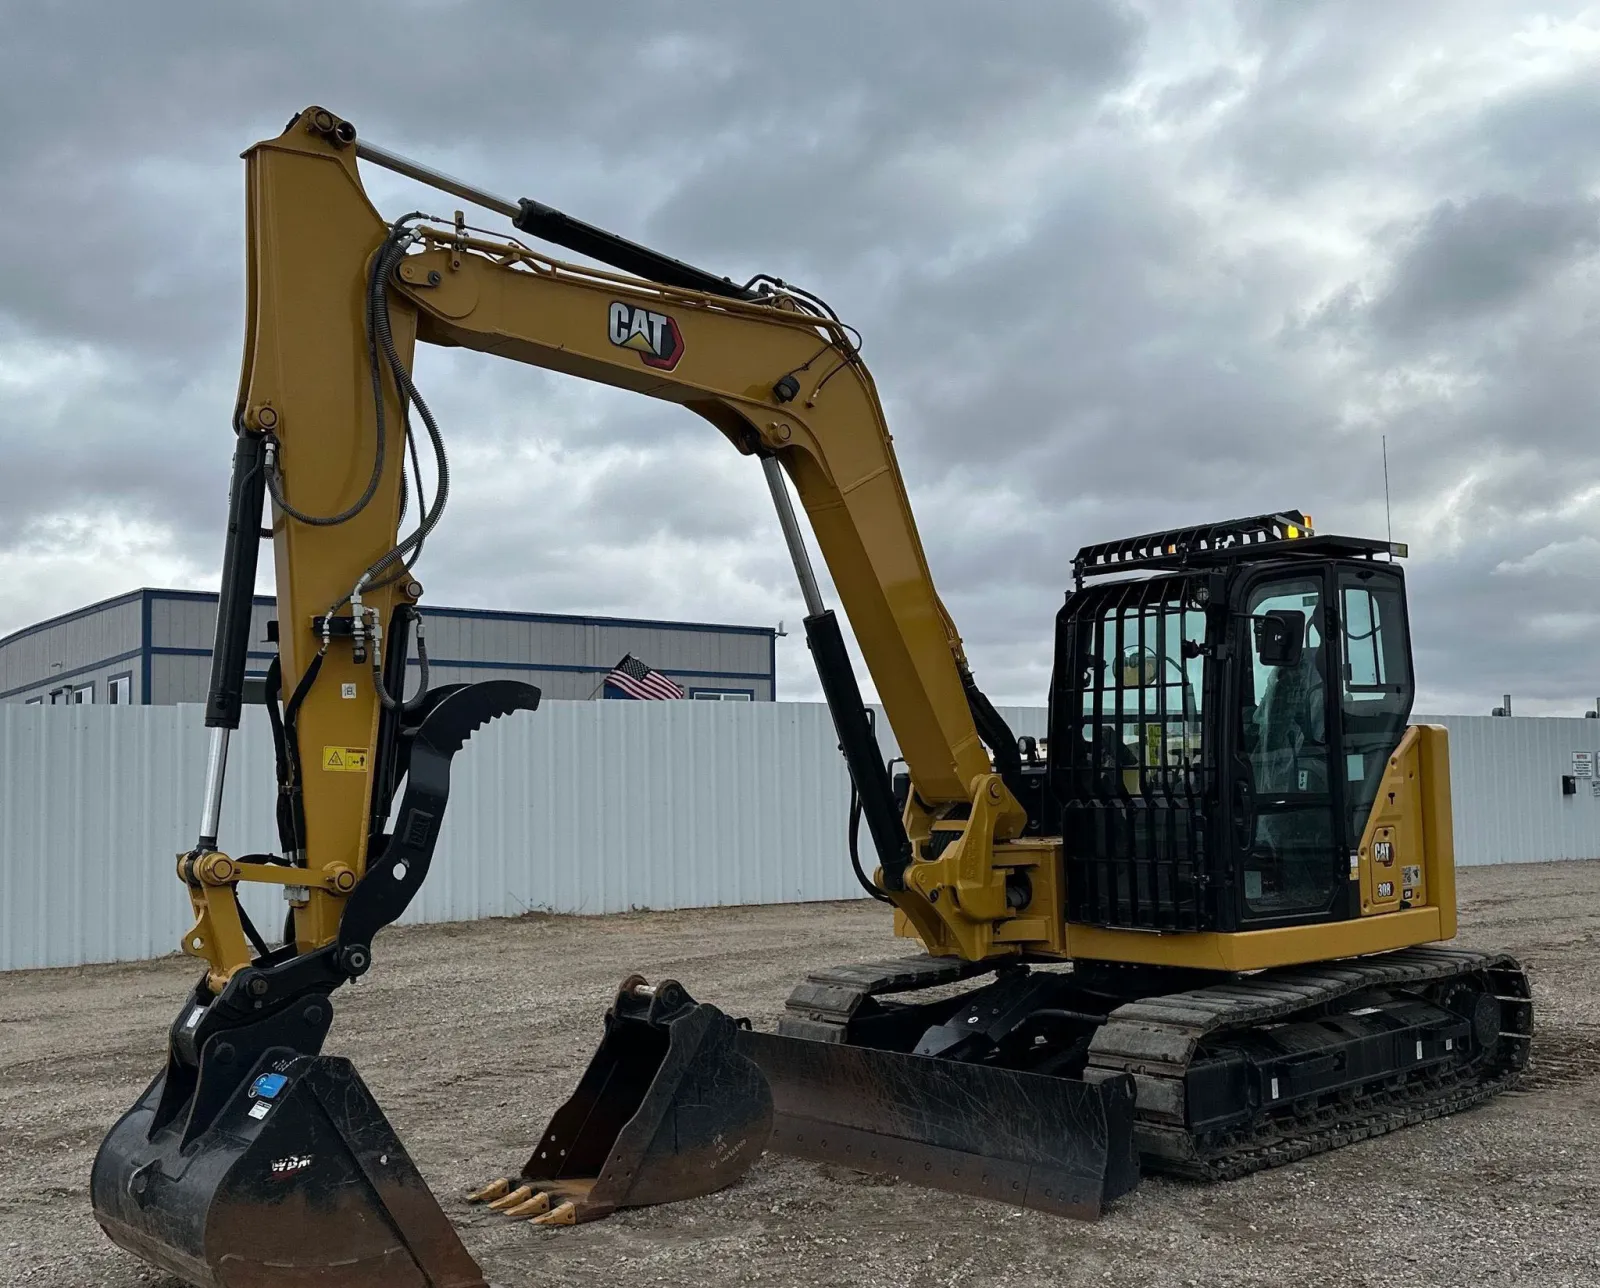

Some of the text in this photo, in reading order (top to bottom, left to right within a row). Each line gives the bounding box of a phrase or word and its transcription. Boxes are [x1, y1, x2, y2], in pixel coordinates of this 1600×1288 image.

[609, 302, 667, 356] CAT
[1374, 842, 1390, 862] CAT
[1377, 882, 1391, 897] 308
